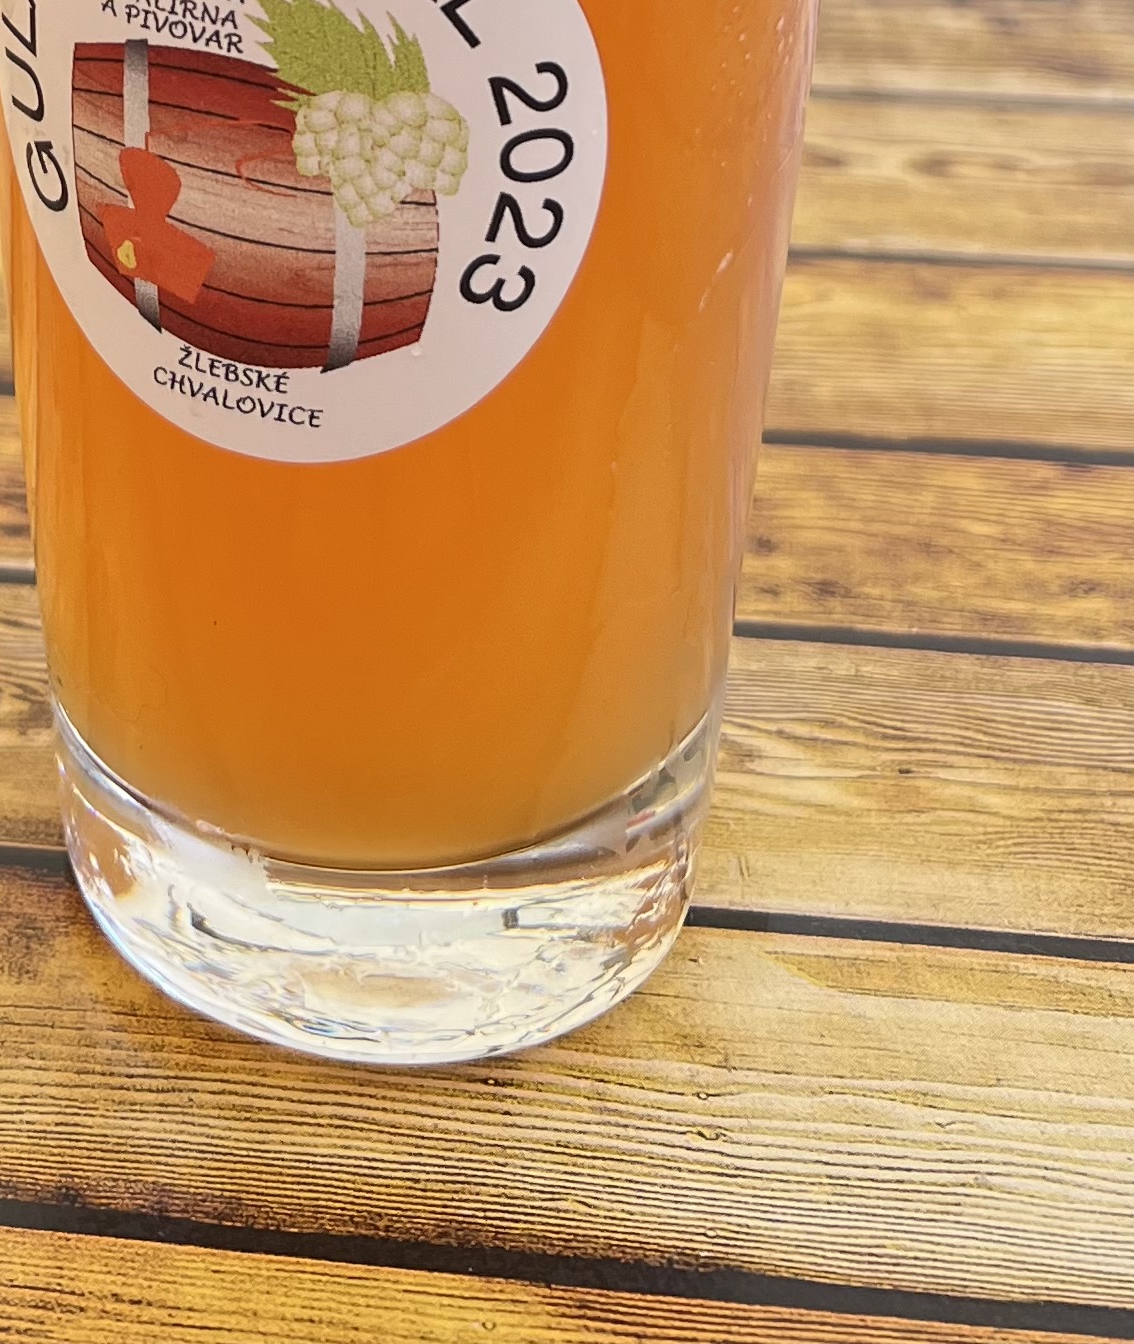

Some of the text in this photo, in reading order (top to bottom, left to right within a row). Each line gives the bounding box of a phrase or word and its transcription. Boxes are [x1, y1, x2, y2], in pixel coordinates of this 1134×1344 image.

[124, 4, 244, 54] PIVOVAR
[459, 61, 575, 312] 2023
[153, 366, 324, 429] CHVALOVICE
[178, 344, 290, 395] ŽLEBSKÉ
